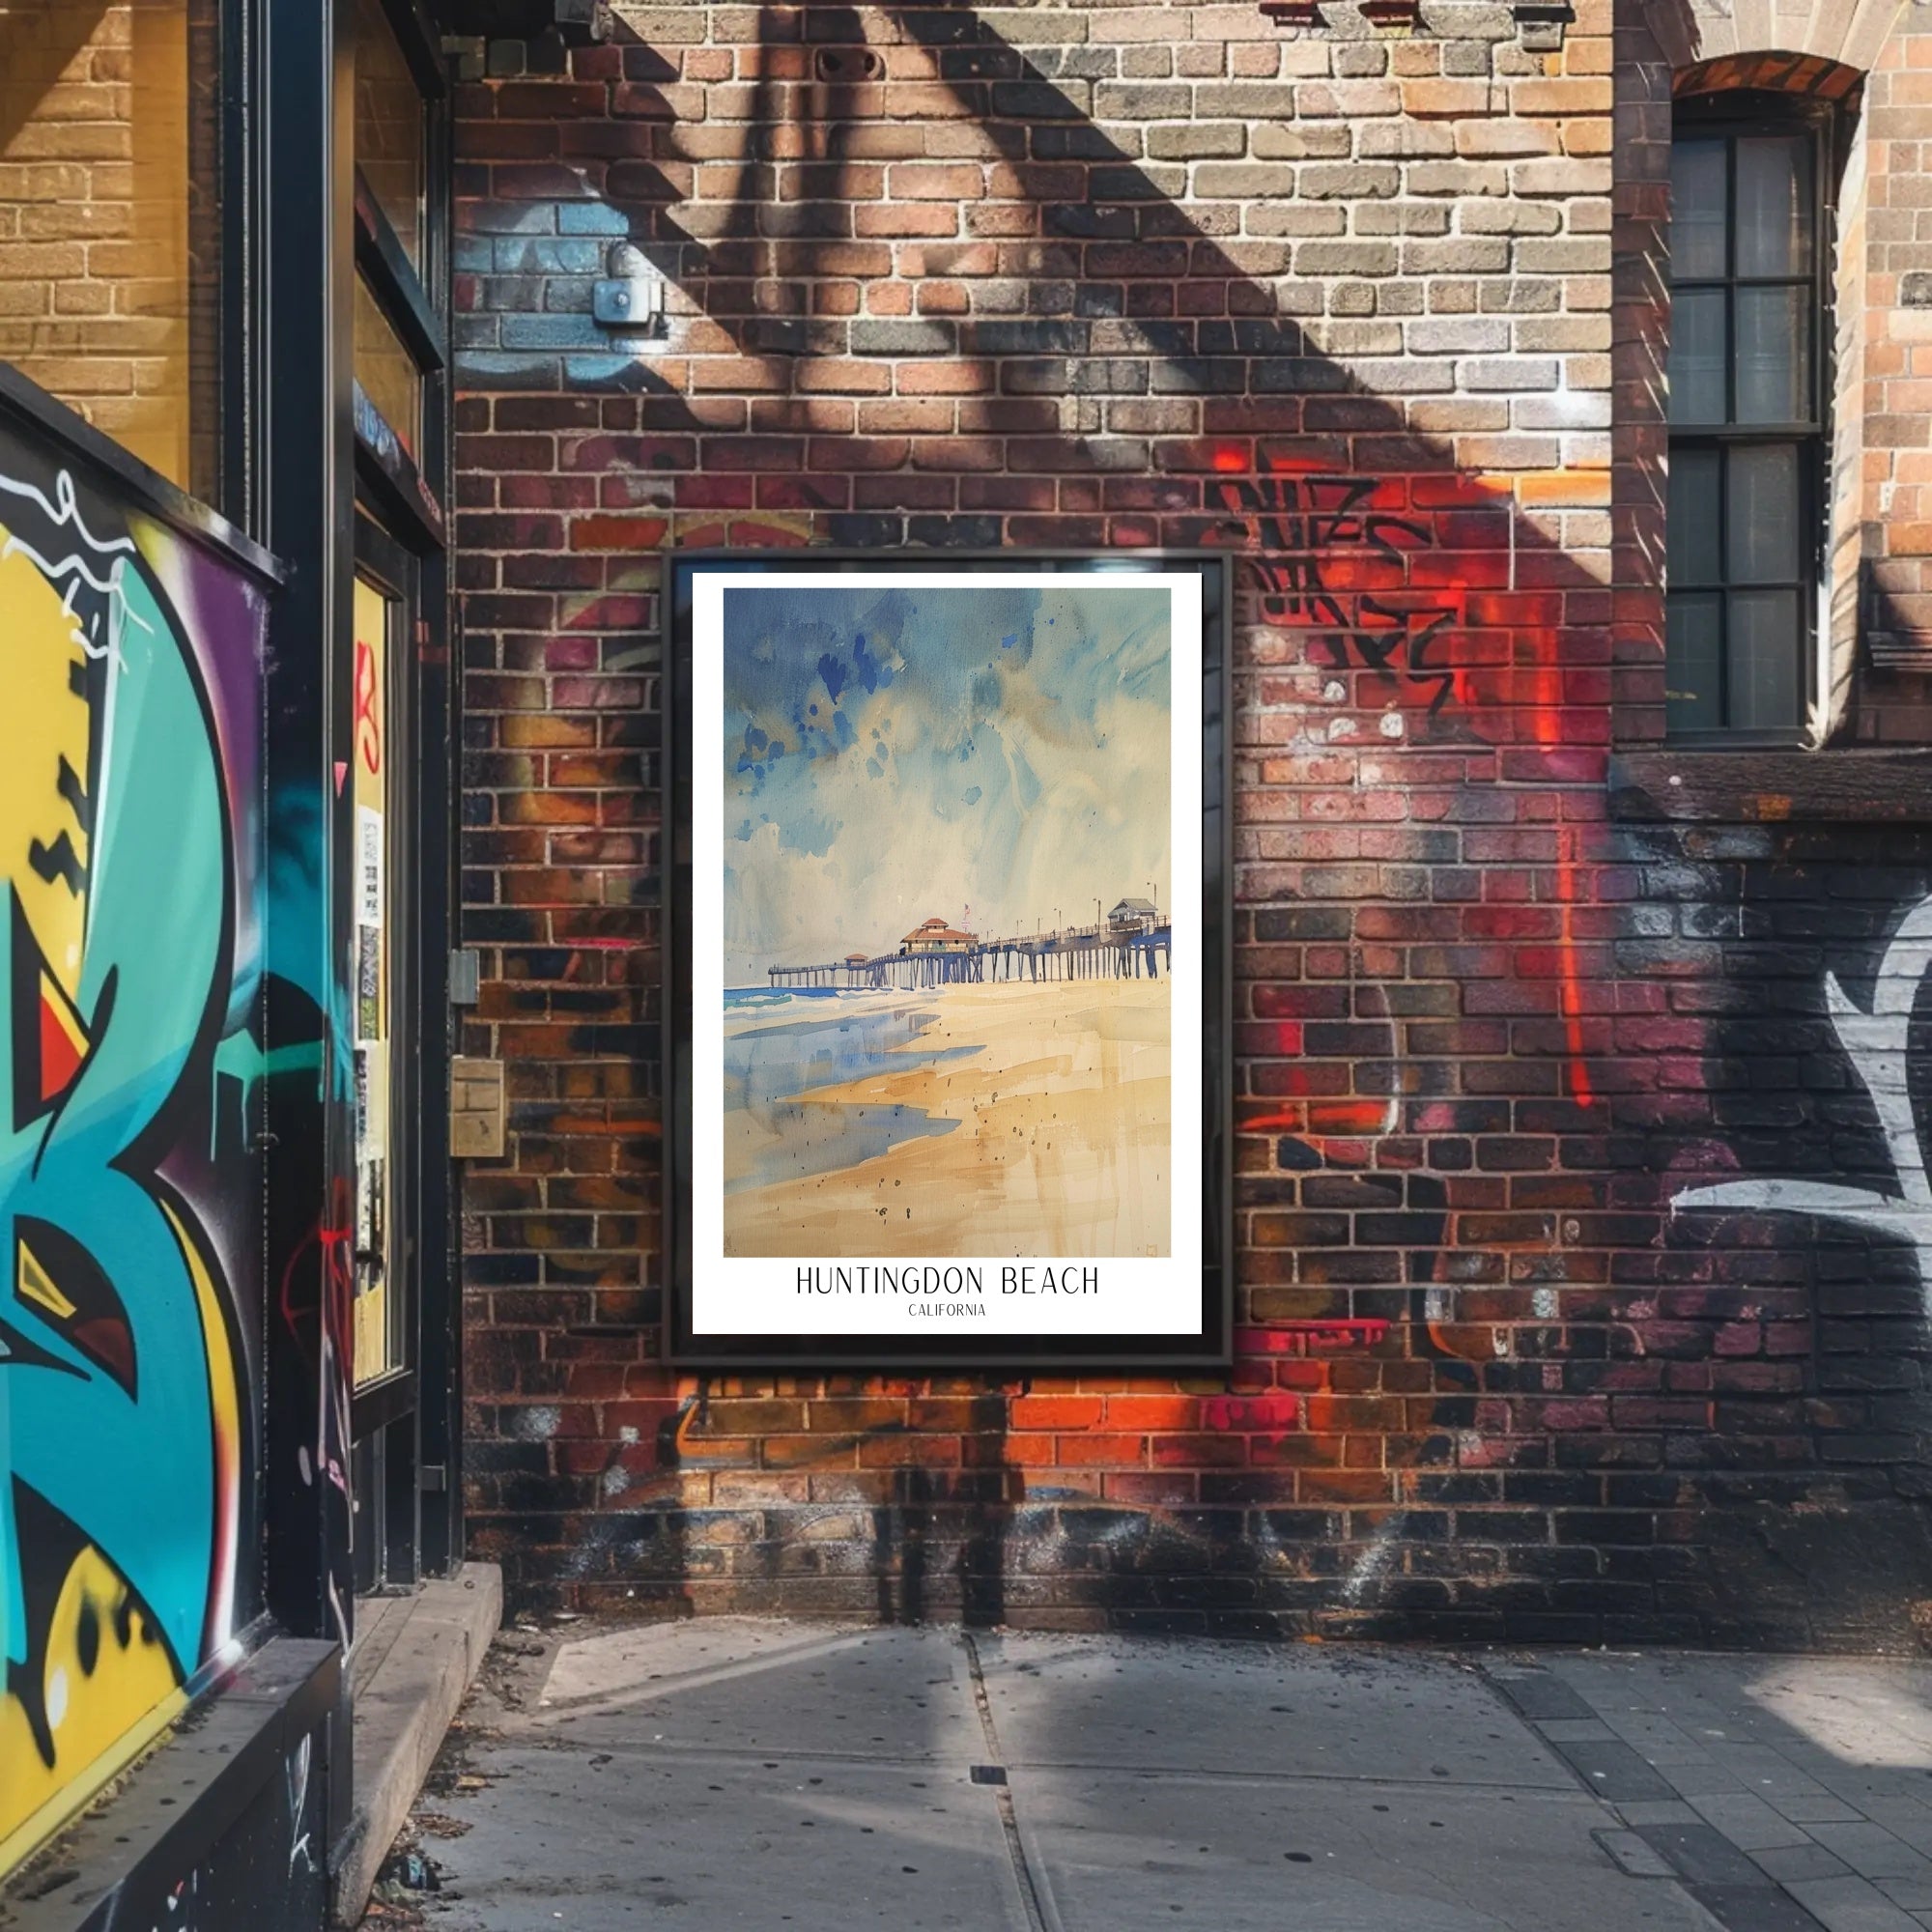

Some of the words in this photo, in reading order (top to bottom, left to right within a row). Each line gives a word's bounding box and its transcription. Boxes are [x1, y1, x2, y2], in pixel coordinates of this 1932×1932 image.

[797, 1266, 981, 1293] HUNTINGDON
[1002, 1266, 1098, 1293] BEACH
[908, 1303, 986, 1317] CALIFORNIA
